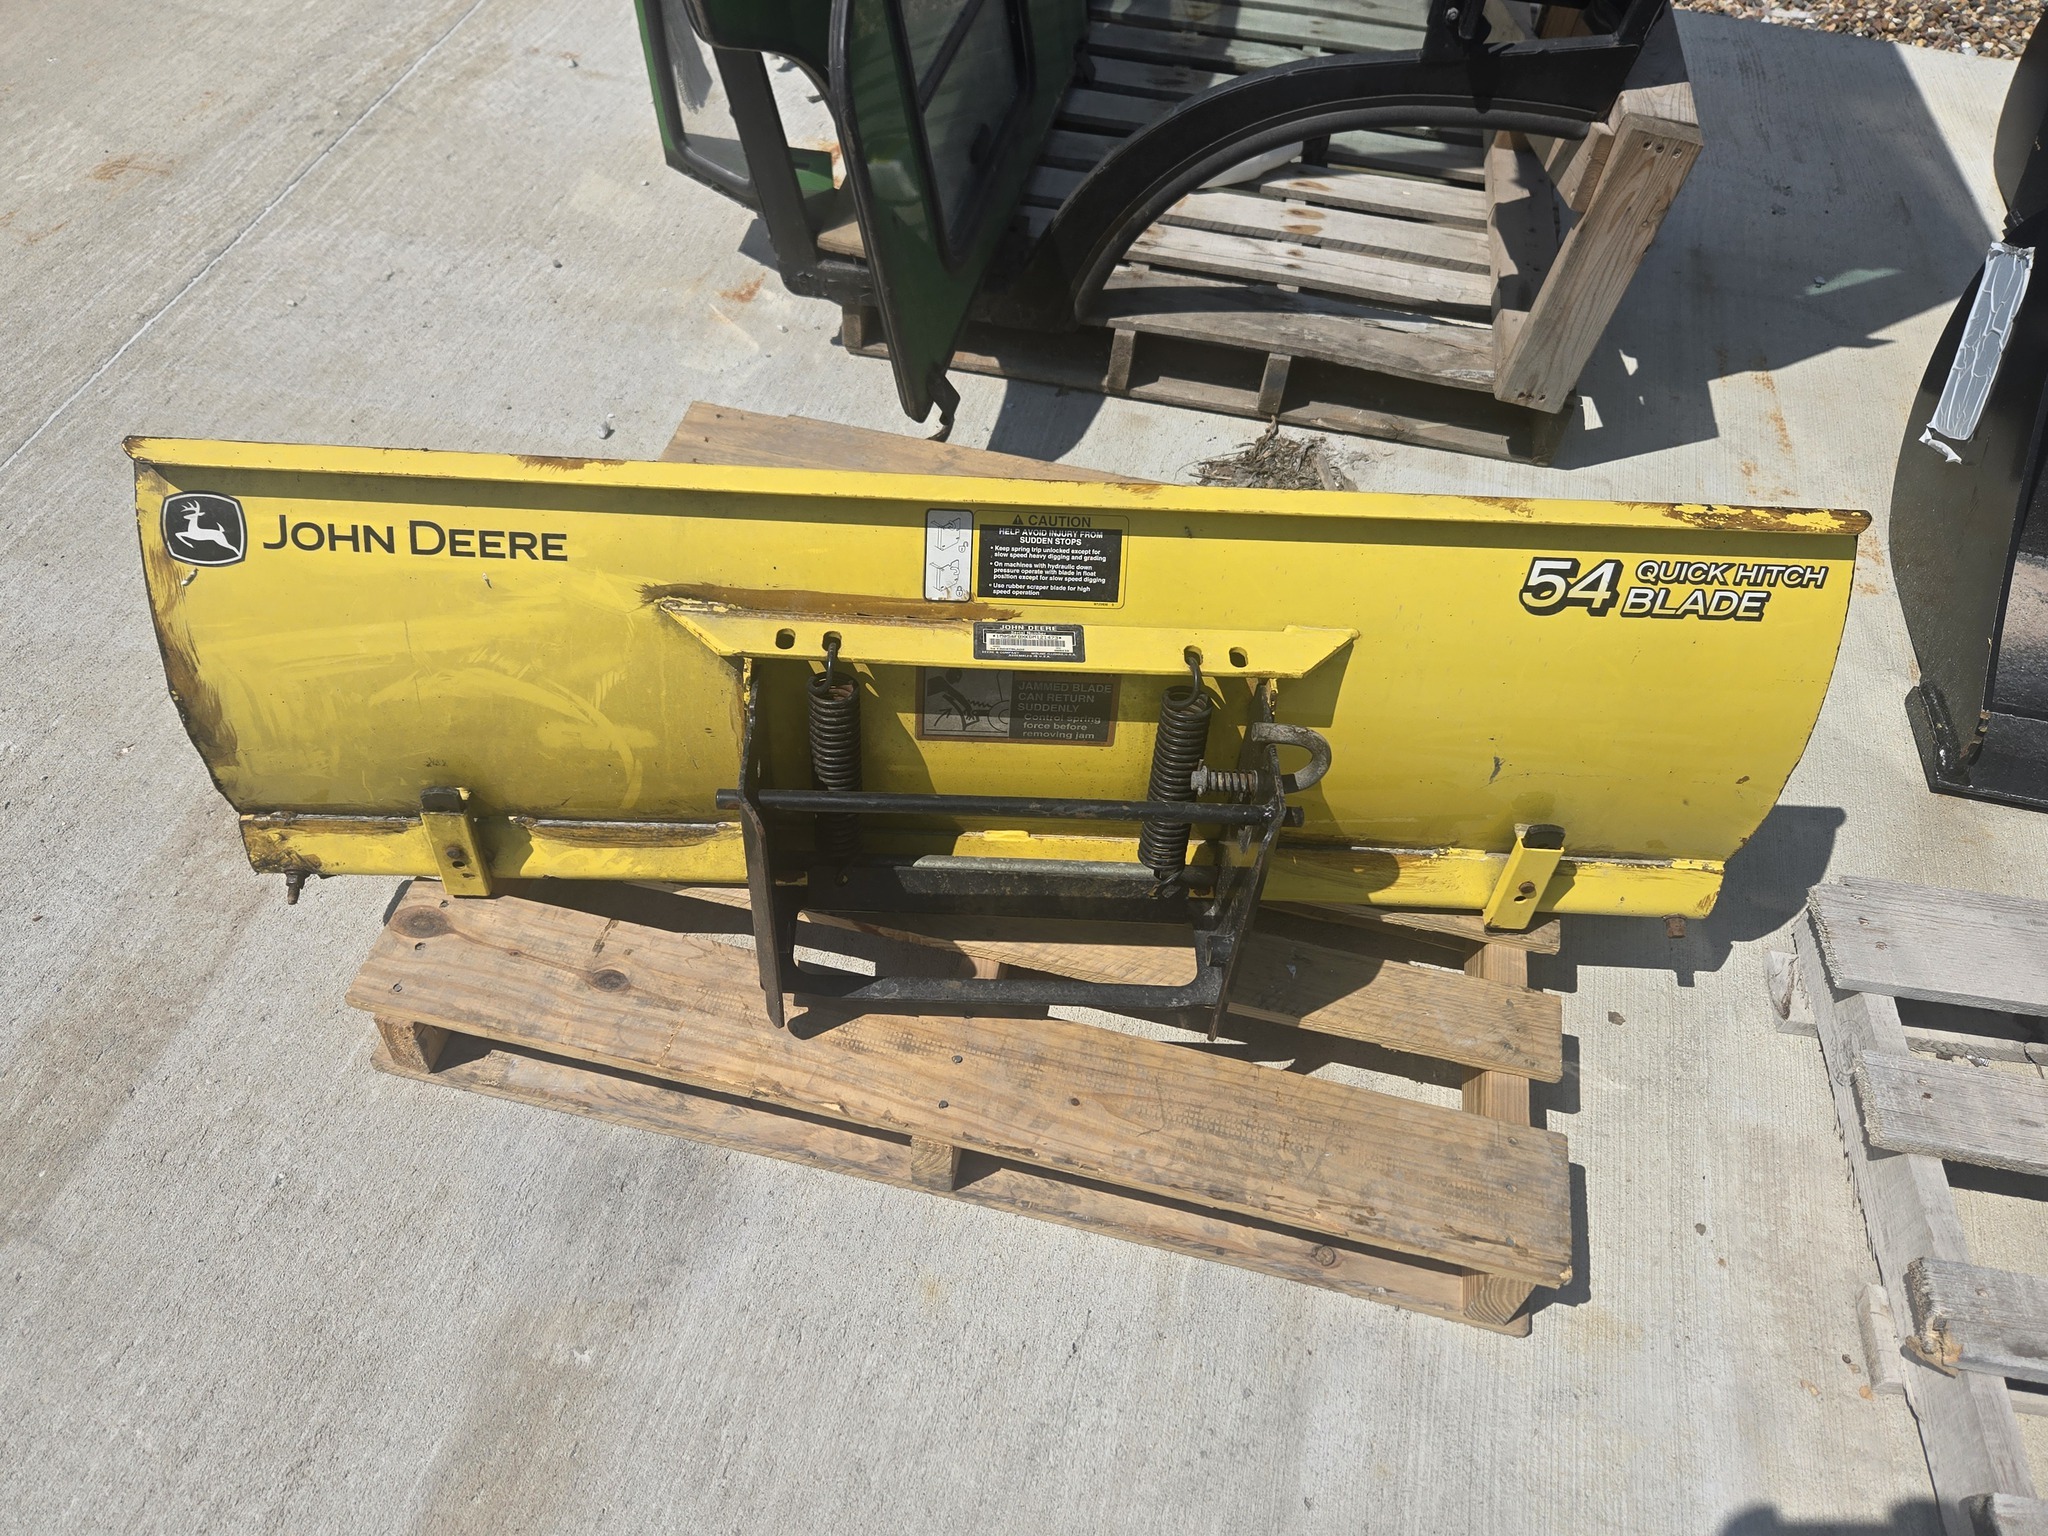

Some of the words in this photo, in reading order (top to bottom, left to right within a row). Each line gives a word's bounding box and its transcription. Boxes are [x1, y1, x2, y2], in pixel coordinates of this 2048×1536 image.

[1028, 515, 1091, 527] CAUTION
[263, 514, 396, 554] JOHN
[410, 520, 568, 562] DEERE
[1080, 530, 1103, 538] FROM
[1636, 560, 1737, 587] QUICK
[1734, 564, 1829, 589] HITCH
[1519, 556, 1624, 617] 54
[1620, 587, 1771, 622] BLADE
[1019, 682, 1069, 692] JAMMED
[1073, 684, 1112, 693] BLADE
[1018, 693, 1043, 701] CAN
[1047, 694, 1094, 703] RETURN
[1018, 703, 1079, 712] SUDDENLY
[1067, 715, 1100, 724] spring
[1023, 731, 1072, 739] removing
